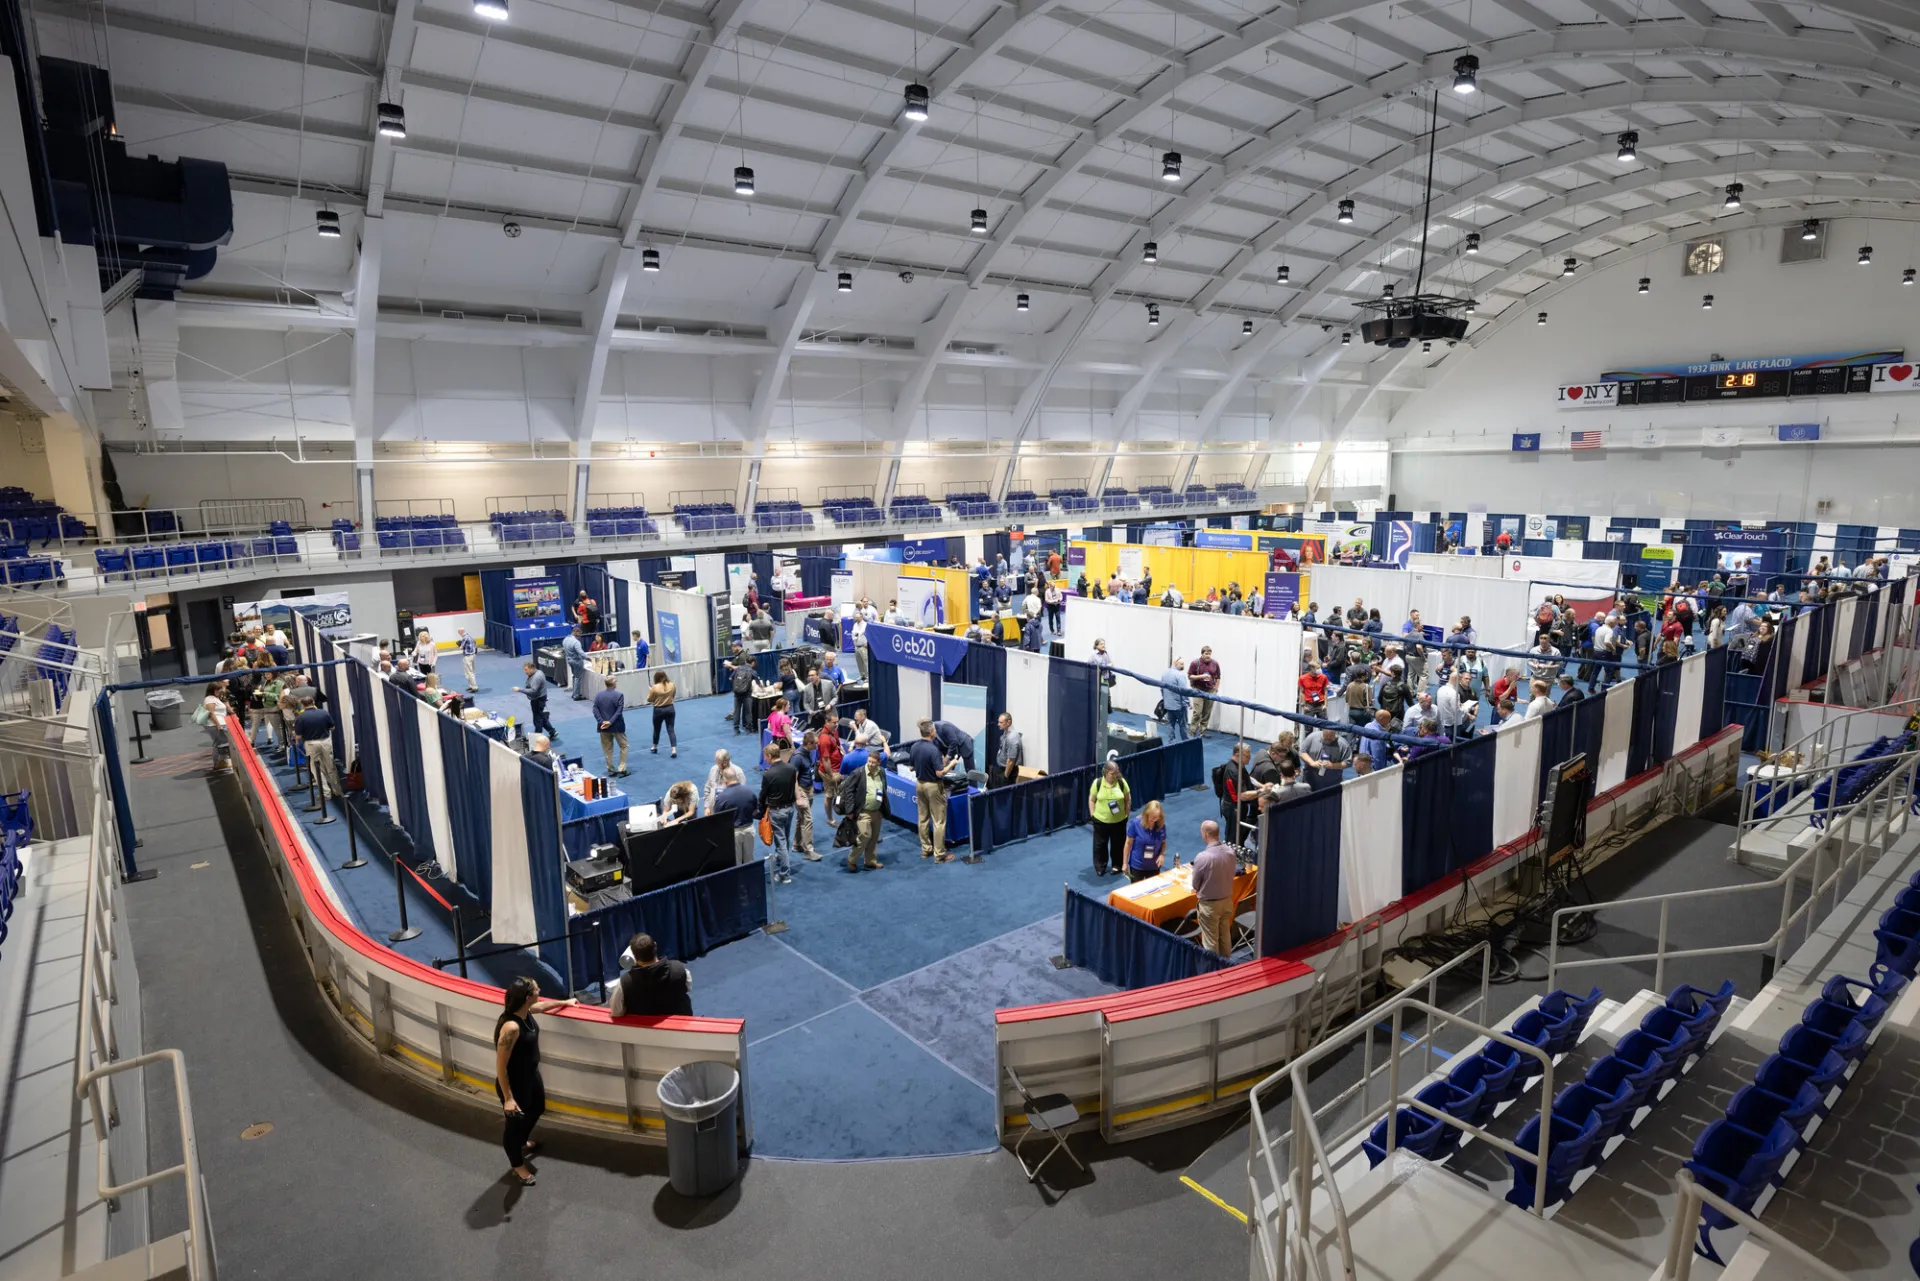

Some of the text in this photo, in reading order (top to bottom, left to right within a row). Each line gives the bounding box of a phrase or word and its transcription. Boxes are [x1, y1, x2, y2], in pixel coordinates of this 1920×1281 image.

[1688, 358, 1791, 374] 1932 RINK LAKE PLACID
[1875, 365, 1887, 383] I
[1726, 373, 1755, 387] 2:18
[1558, 384, 1617, 401] I NY
[904, 636, 936, 658] cb20
